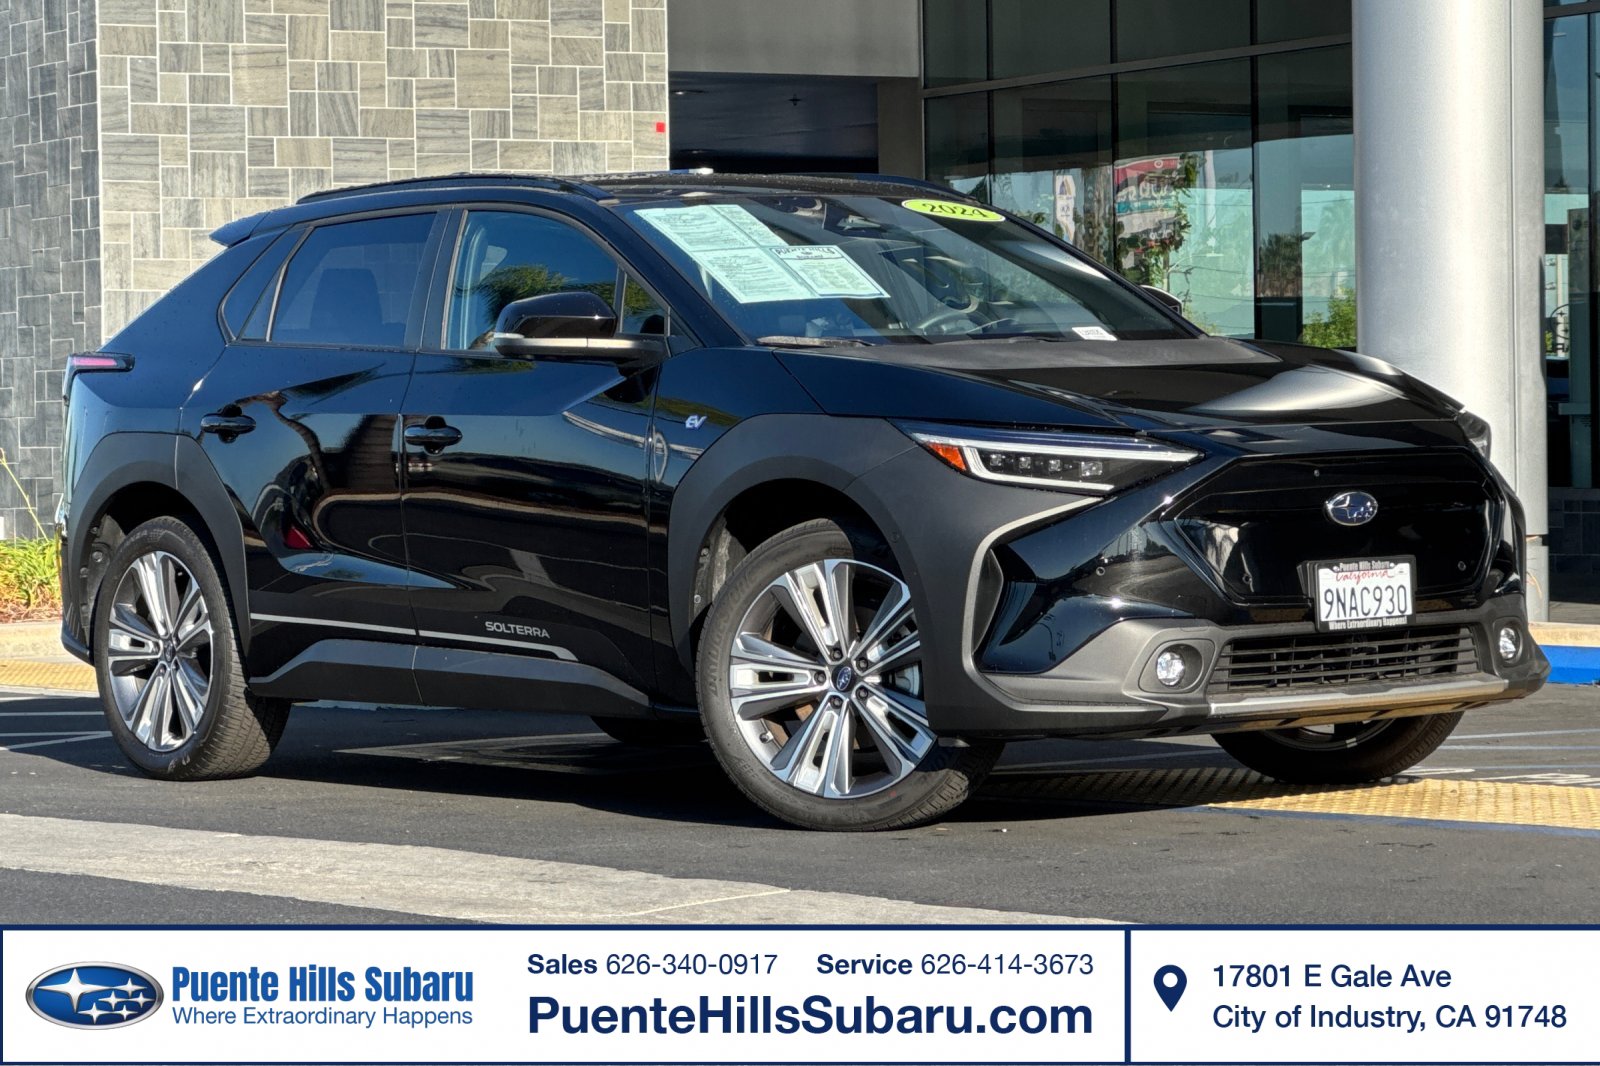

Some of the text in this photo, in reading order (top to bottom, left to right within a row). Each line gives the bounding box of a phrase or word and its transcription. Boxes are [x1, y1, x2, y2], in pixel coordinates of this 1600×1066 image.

[921, 202, 990, 219] 2024
[685, 414, 708, 429] EV
[1339, 560, 1390, 572] Puente Hills Subaru
[1335, 569, 1395, 585] California
[1324, 585, 1408, 619] 9NAC930
[484, 621, 551, 639] SOLTERRA
[1328, 620, 1346, 631] Where
[1347, 618, 1382, 629] Extraordinary
